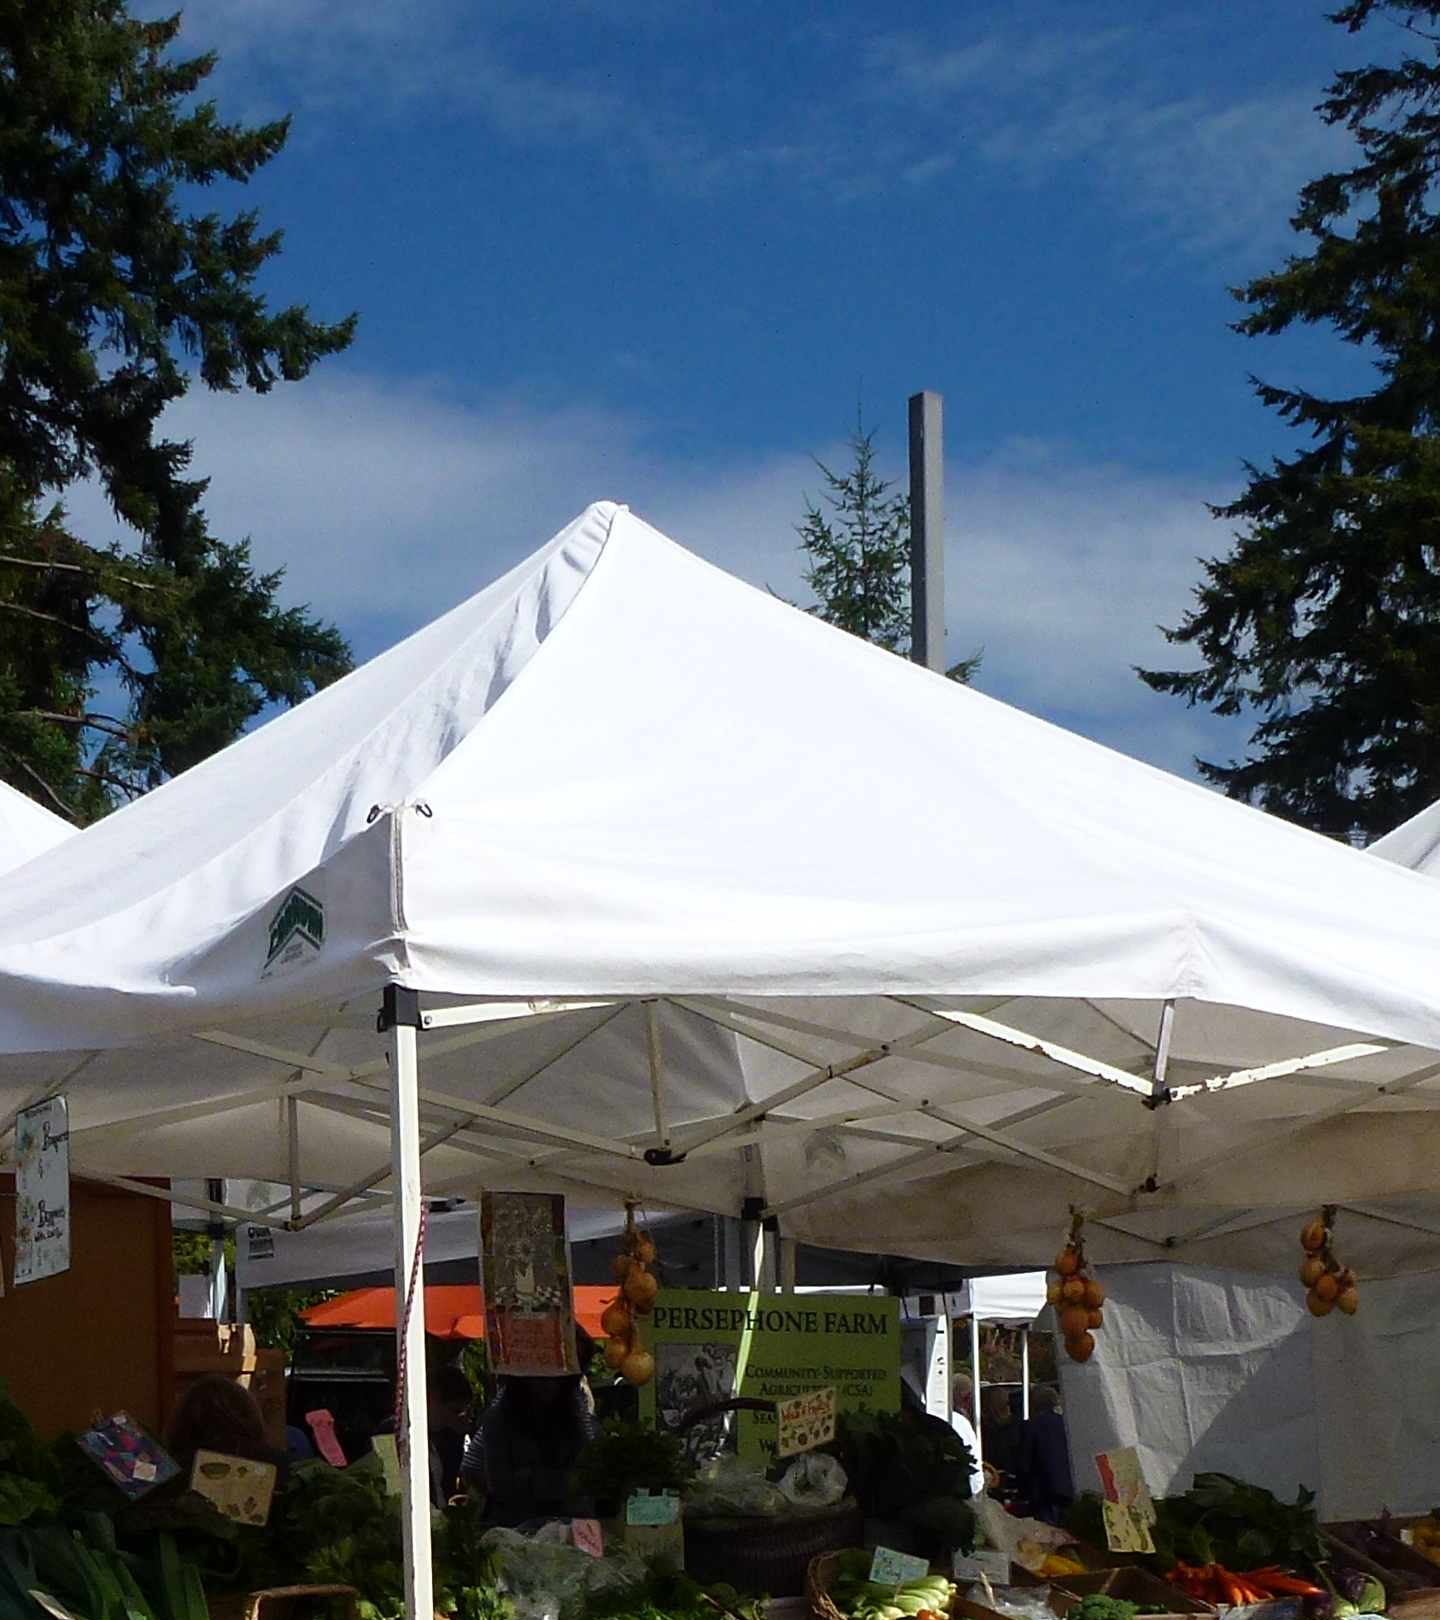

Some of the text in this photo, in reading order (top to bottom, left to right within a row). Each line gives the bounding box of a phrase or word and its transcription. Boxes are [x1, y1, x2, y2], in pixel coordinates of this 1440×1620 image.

[653, 1307, 888, 1335] PERSEPHONE FARM
[745, 1364, 887, 1381] COMMUNITY-SUPPORTED
